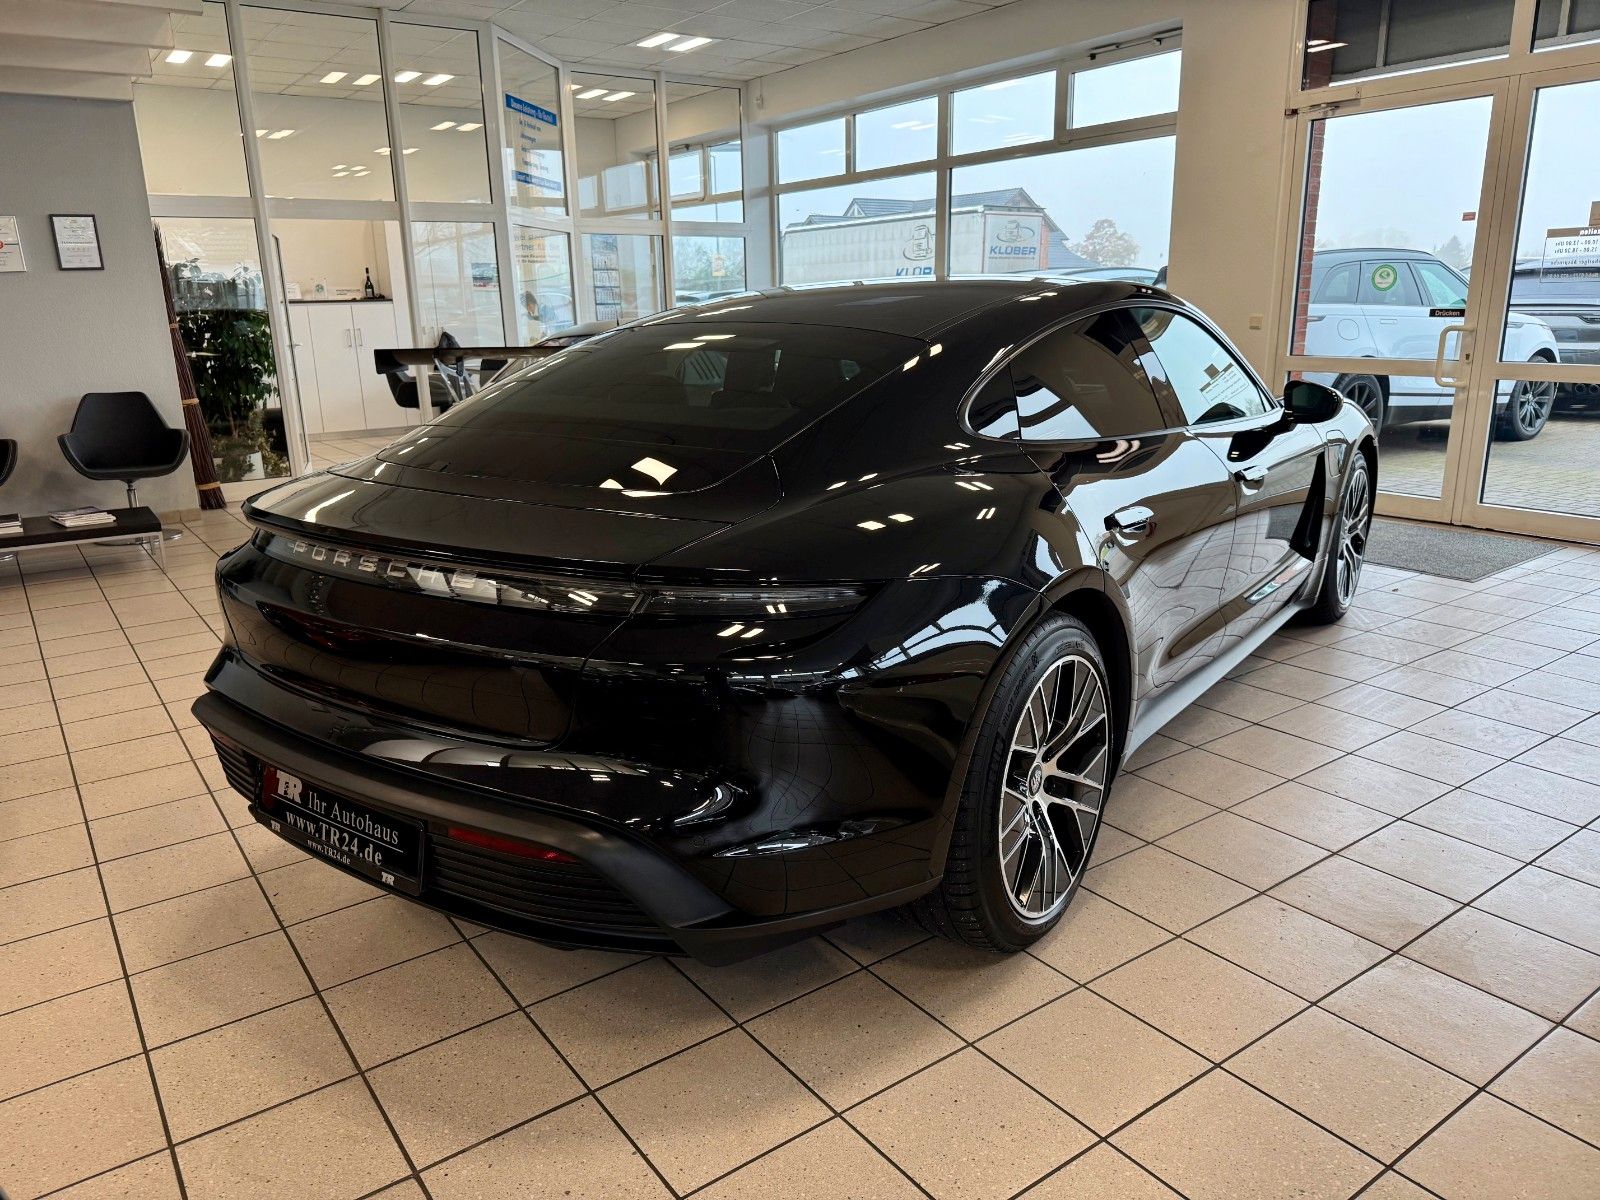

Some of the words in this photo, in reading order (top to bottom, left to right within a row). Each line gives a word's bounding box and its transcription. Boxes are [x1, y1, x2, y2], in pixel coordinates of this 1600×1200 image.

[292, 541, 478, 588] PORSCHE
[276, 769, 302, 804] TR
[286, 811, 382, 866] www.TR24.de
[308, 790, 327, 814] Ihr
[330, 802, 399, 844] Autohaus
[307, 839, 351, 865] www.TR24.de
